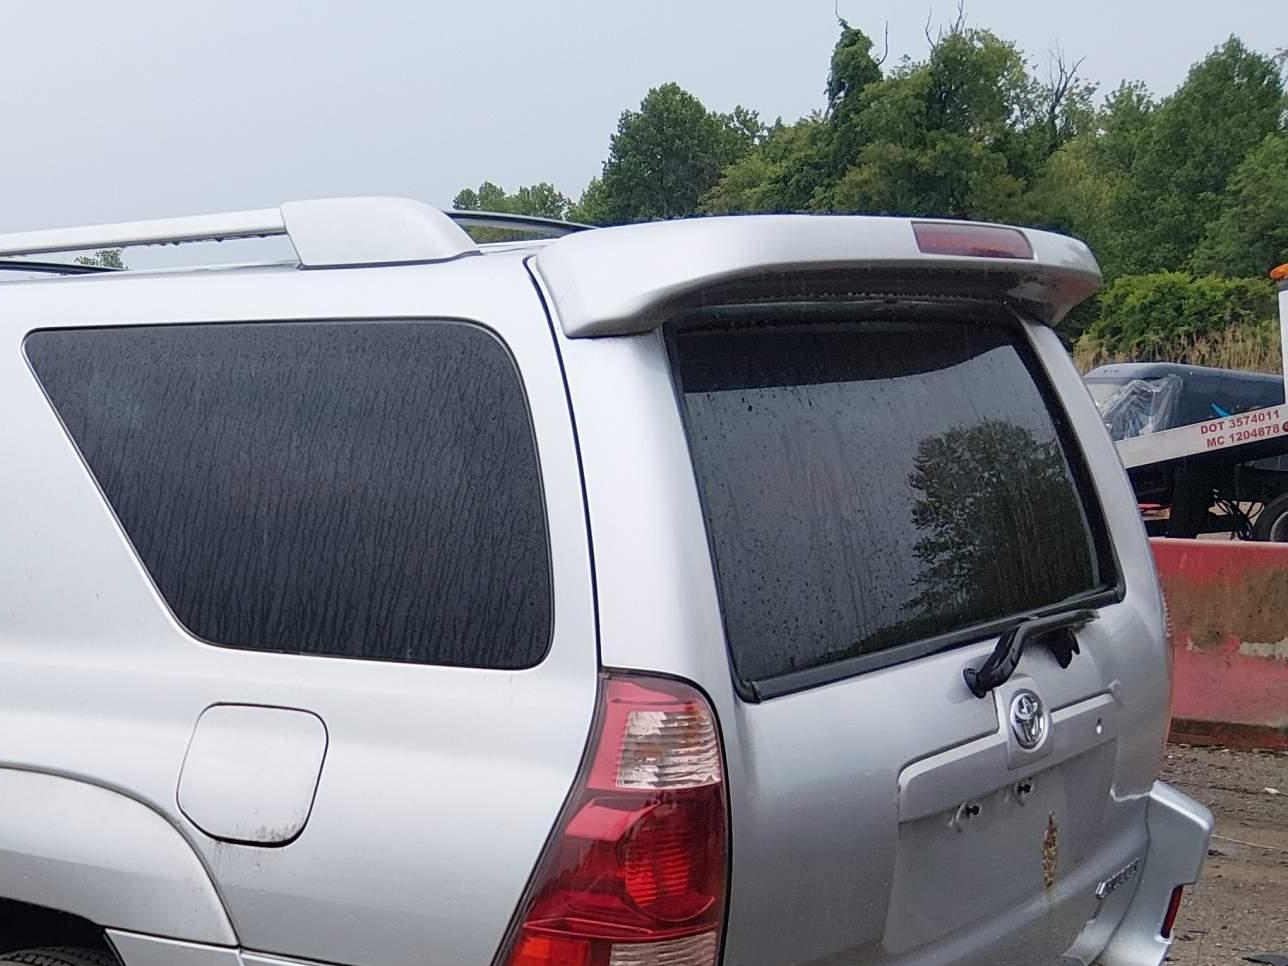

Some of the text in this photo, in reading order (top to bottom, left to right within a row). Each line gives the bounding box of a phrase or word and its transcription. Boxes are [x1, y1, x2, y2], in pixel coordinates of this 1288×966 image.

[1200, 409, 1280, 435] DOT 3574011
[1206, 424, 1280, 448] MC 1204878
